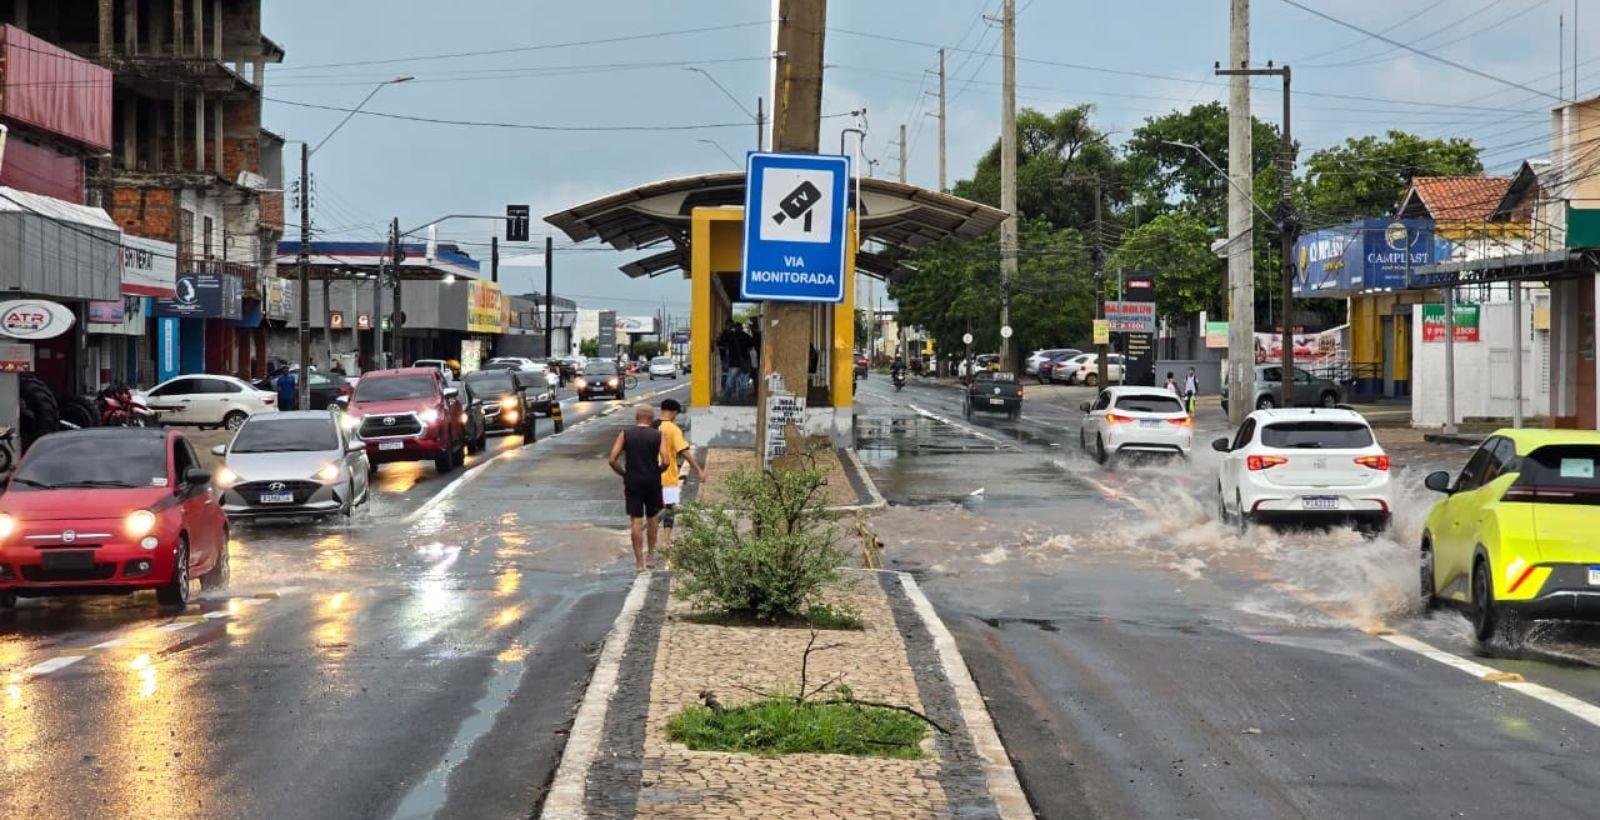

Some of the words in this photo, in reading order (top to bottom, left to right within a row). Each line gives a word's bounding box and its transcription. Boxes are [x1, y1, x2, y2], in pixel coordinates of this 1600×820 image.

[790, 190, 809, 209] TV
[784, 255, 805, 267] VIA
[1368, 251, 1429, 264] CAMPLAST
[751, 271, 835, 285] MONITORADA
[8, 313, 45, 322] ATR
